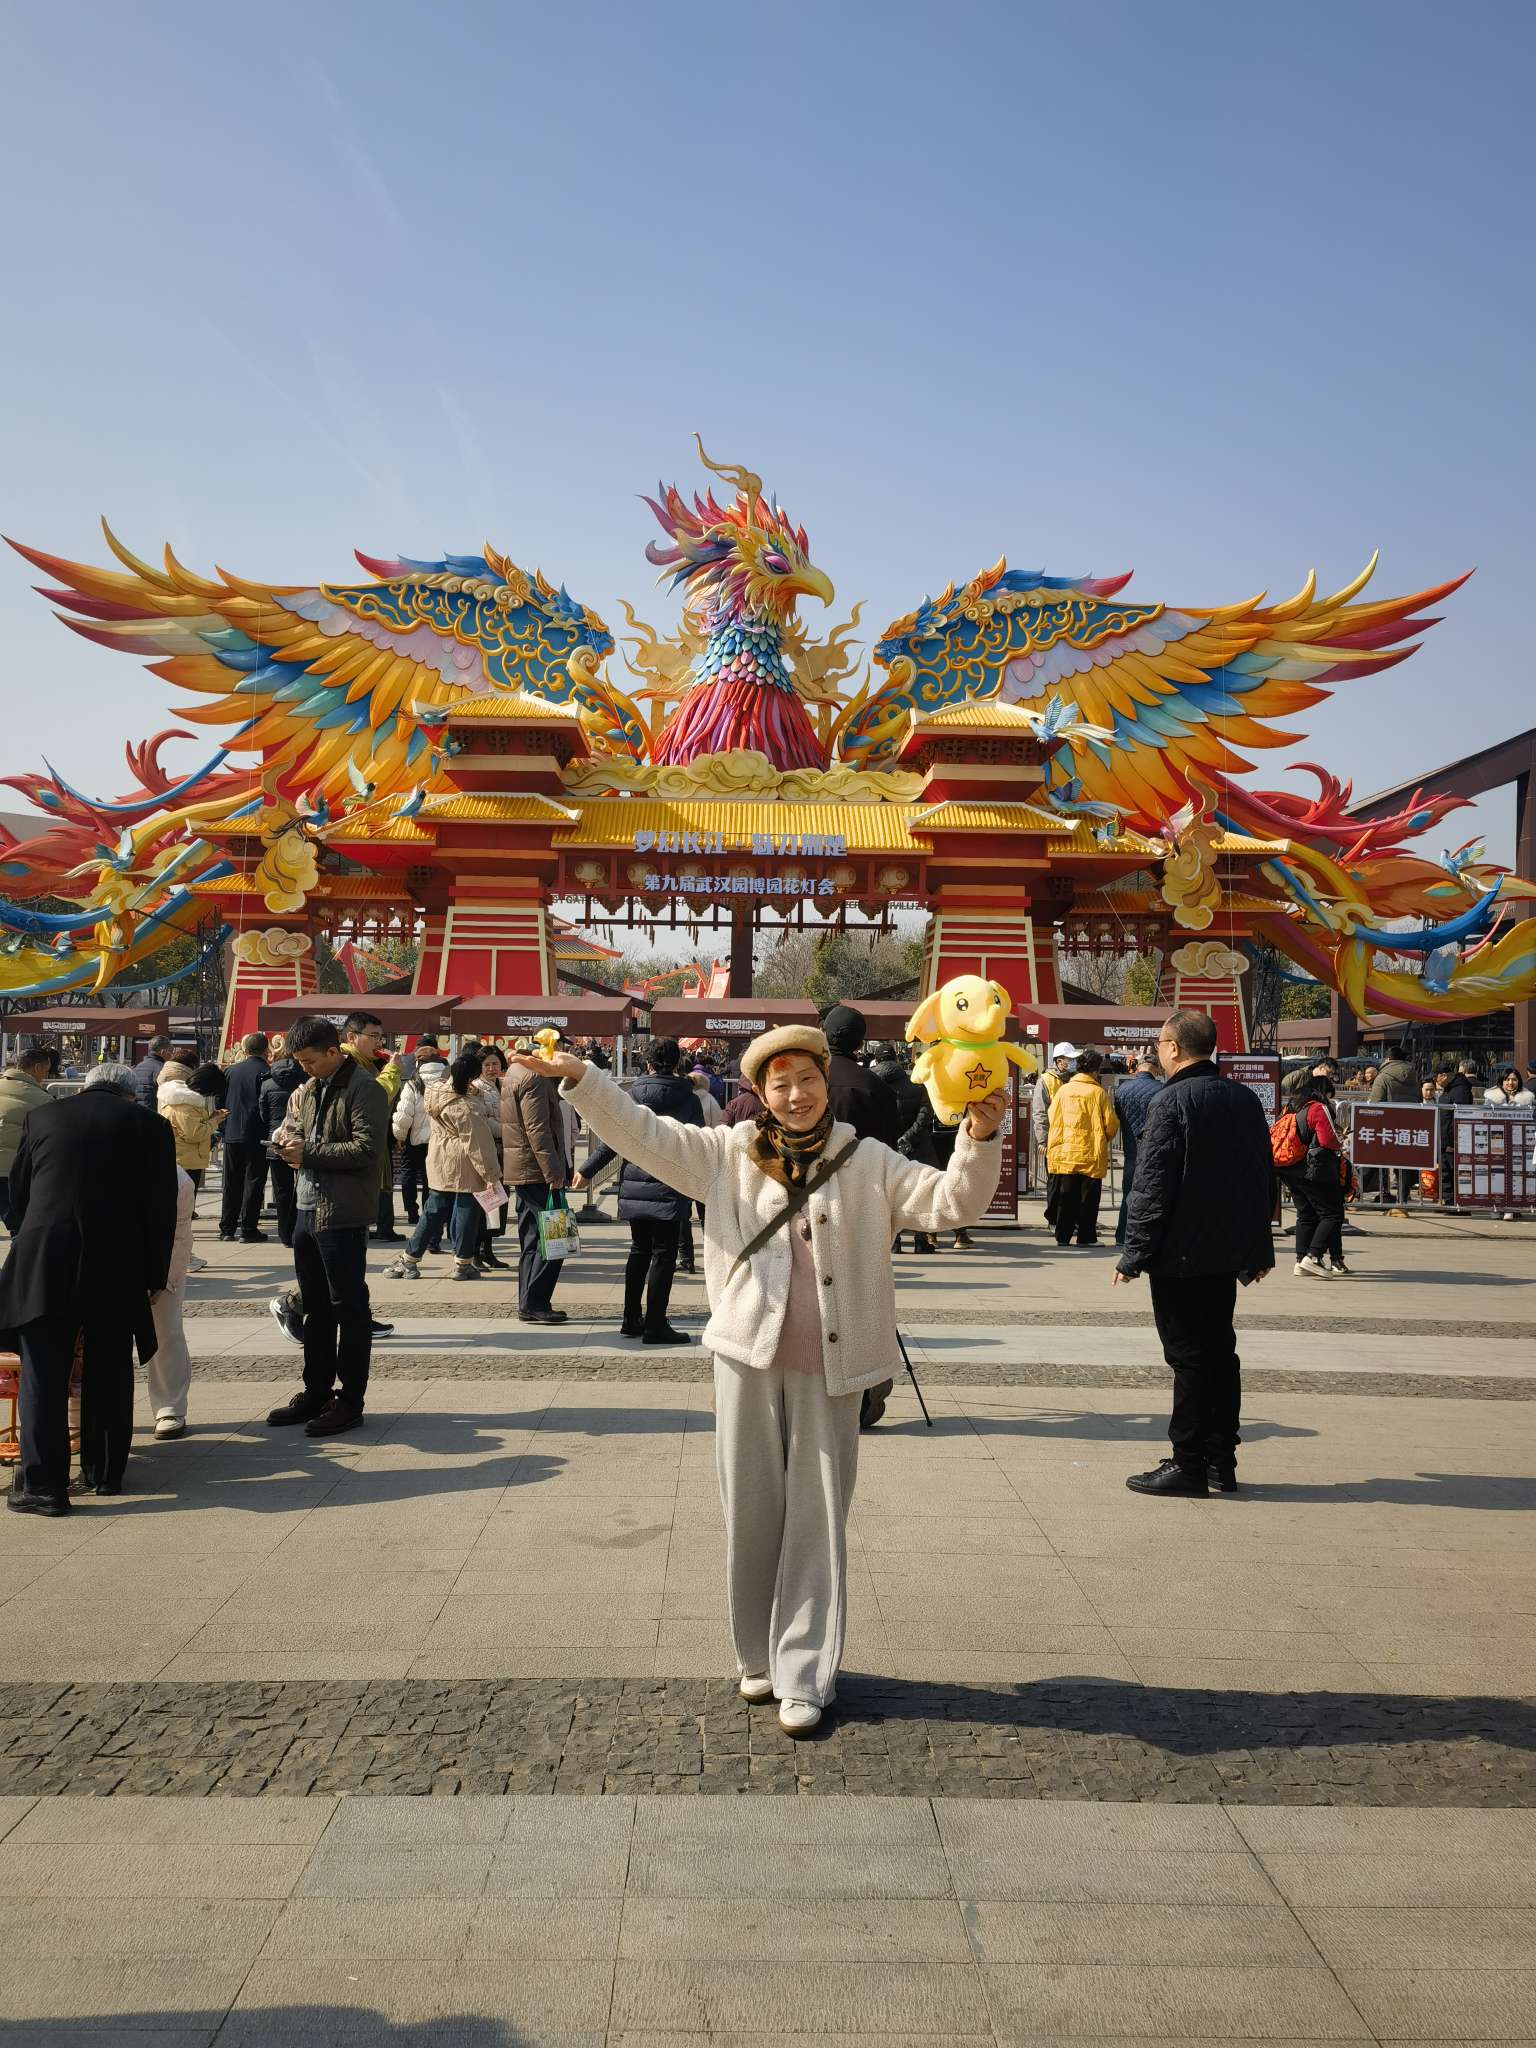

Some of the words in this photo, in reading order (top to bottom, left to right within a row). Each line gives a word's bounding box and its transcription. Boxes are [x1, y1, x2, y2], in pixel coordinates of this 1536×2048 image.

[644, 874, 835, 896] 第九届武汉园博园花灯会
[1358, 1126, 1430, 1147] 年卡通道
